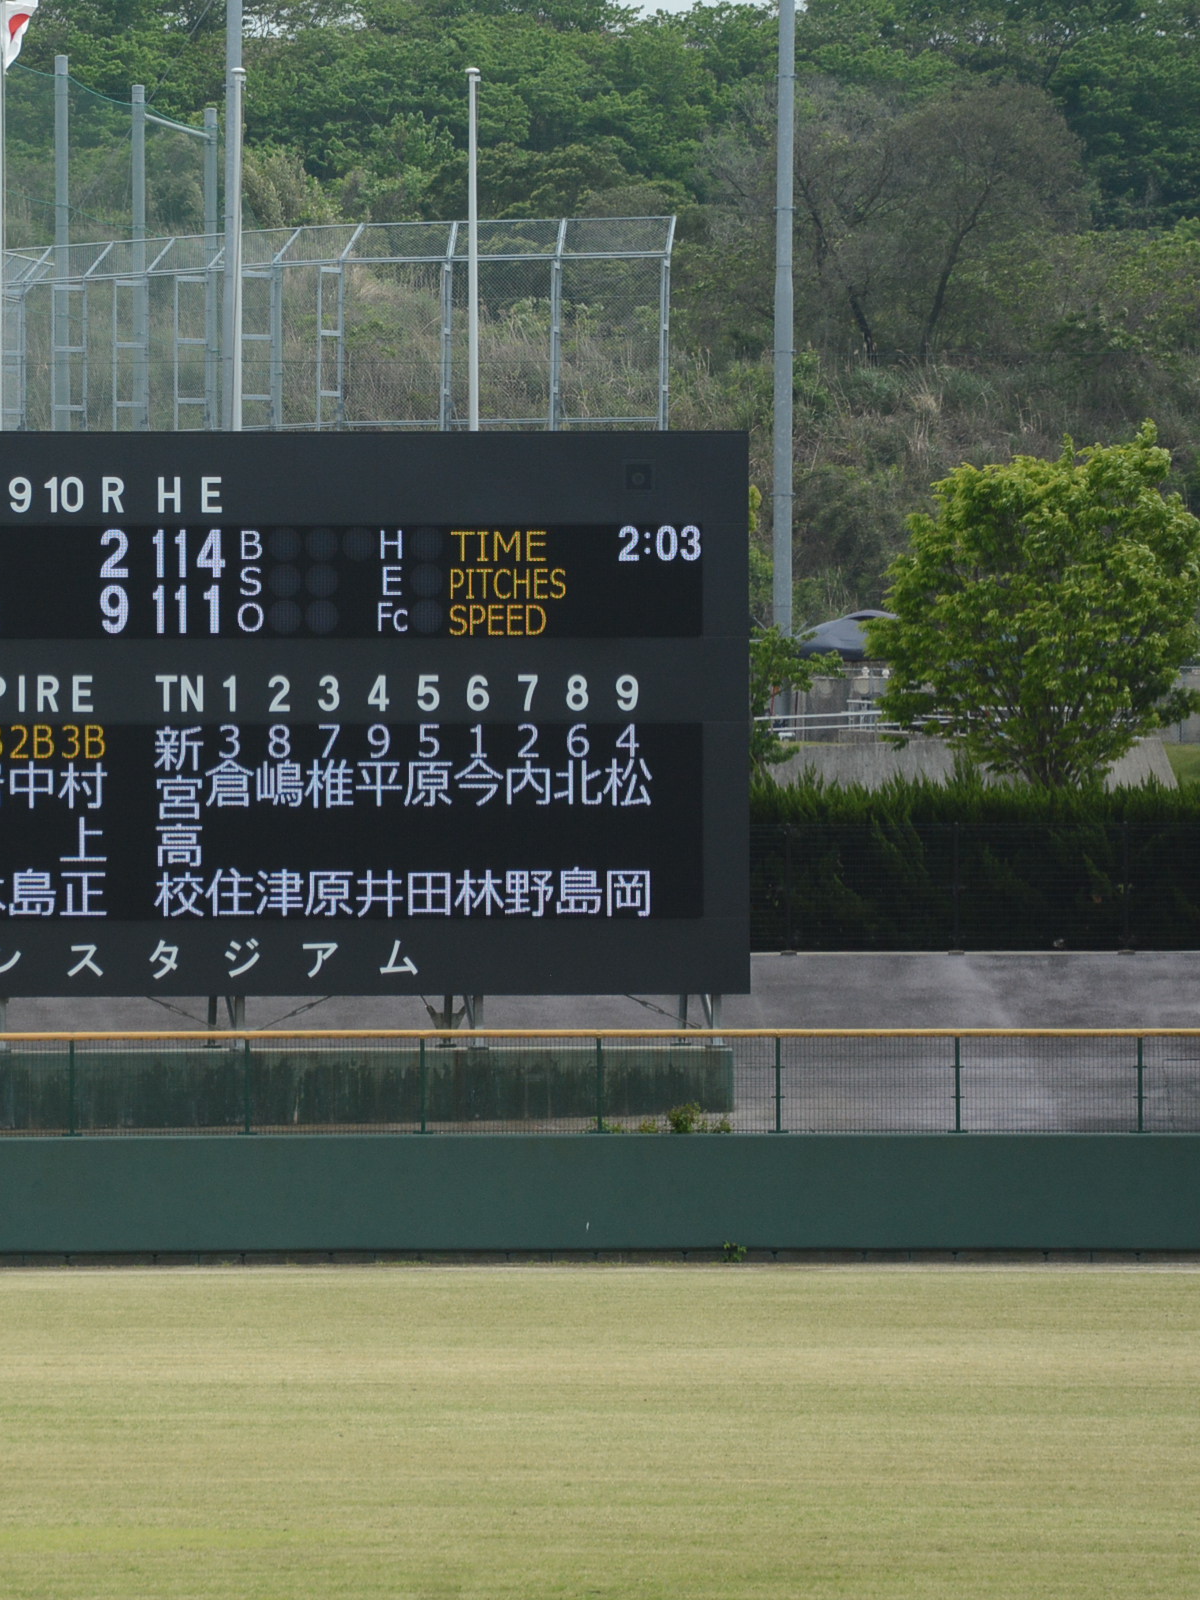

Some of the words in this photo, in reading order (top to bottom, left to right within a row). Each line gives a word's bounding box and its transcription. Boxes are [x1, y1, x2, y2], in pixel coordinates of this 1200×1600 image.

[9, 477, 32, 513] 9
[44, 476, 84, 513] 10
[102, 476, 124, 513] R
[158, 476, 181, 513] H
[201, 476, 222, 513] E
[100, 529, 128, 578] 2
[152, 529, 186, 578] 11
[197, 529, 226, 578] 4
[241, 530, 262, 560] B
[380, 530, 402, 559] H
[451, 531, 546, 561] TIME
[618, 525, 701, 561] 2:03
[240, 567, 262, 596] S
[383, 566, 402, 595] E
[451, 569, 566, 599] PITCHES
[100, 584, 129, 633] 9
[153, 584, 186, 633] 11
[203, 584, 219, 633] 1
[378, 602, 408, 632] Fc
[450, 605, 546, 635] SPEED
[155, 675, 203, 712] TN
[223, 675, 236, 712] 1
[268, 675, 290, 712] 2
[318, 675, 340, 712] 3
[368, 675, 389, 712] 4
[417, 674, 440, 711] 5
[467, 675, 489, 711] 6
[518, 674, 538, 711] 7
[566, 674, 588, 711] 8
[616, 674, 638, 711] 9
[10, 725, 54, 758] 2B
[62, 725, 105, 758] 3B
[219, 724, 240, 758] 3
[268, 724, 290, 758] 8
[319, 724, 340, 758] 7
[368, 724, 390, 758] 9
[419, 724, 439, 758] 5
[470, 724, 487, 758] 1
[518, 723, 539, 758] 2
[567, 724, 589, 757] 6
[616, 724, 639, 757] 4
[9, 761, 56, 916] 中島
[58, 762, 107, 916] 村上正
[154, 726, 204, 917] 新宮高校
[205, 759, 254, 916] 倉住
[356, 762, 403, 917] 平井
[404, 762, 453, 916] 原田
[454, 759, 504, 916] 今林
[505, 760, 552, 917] 内野
[552, 760, 601, 914] 北島
[603, 759, 652, 917] 松岡
